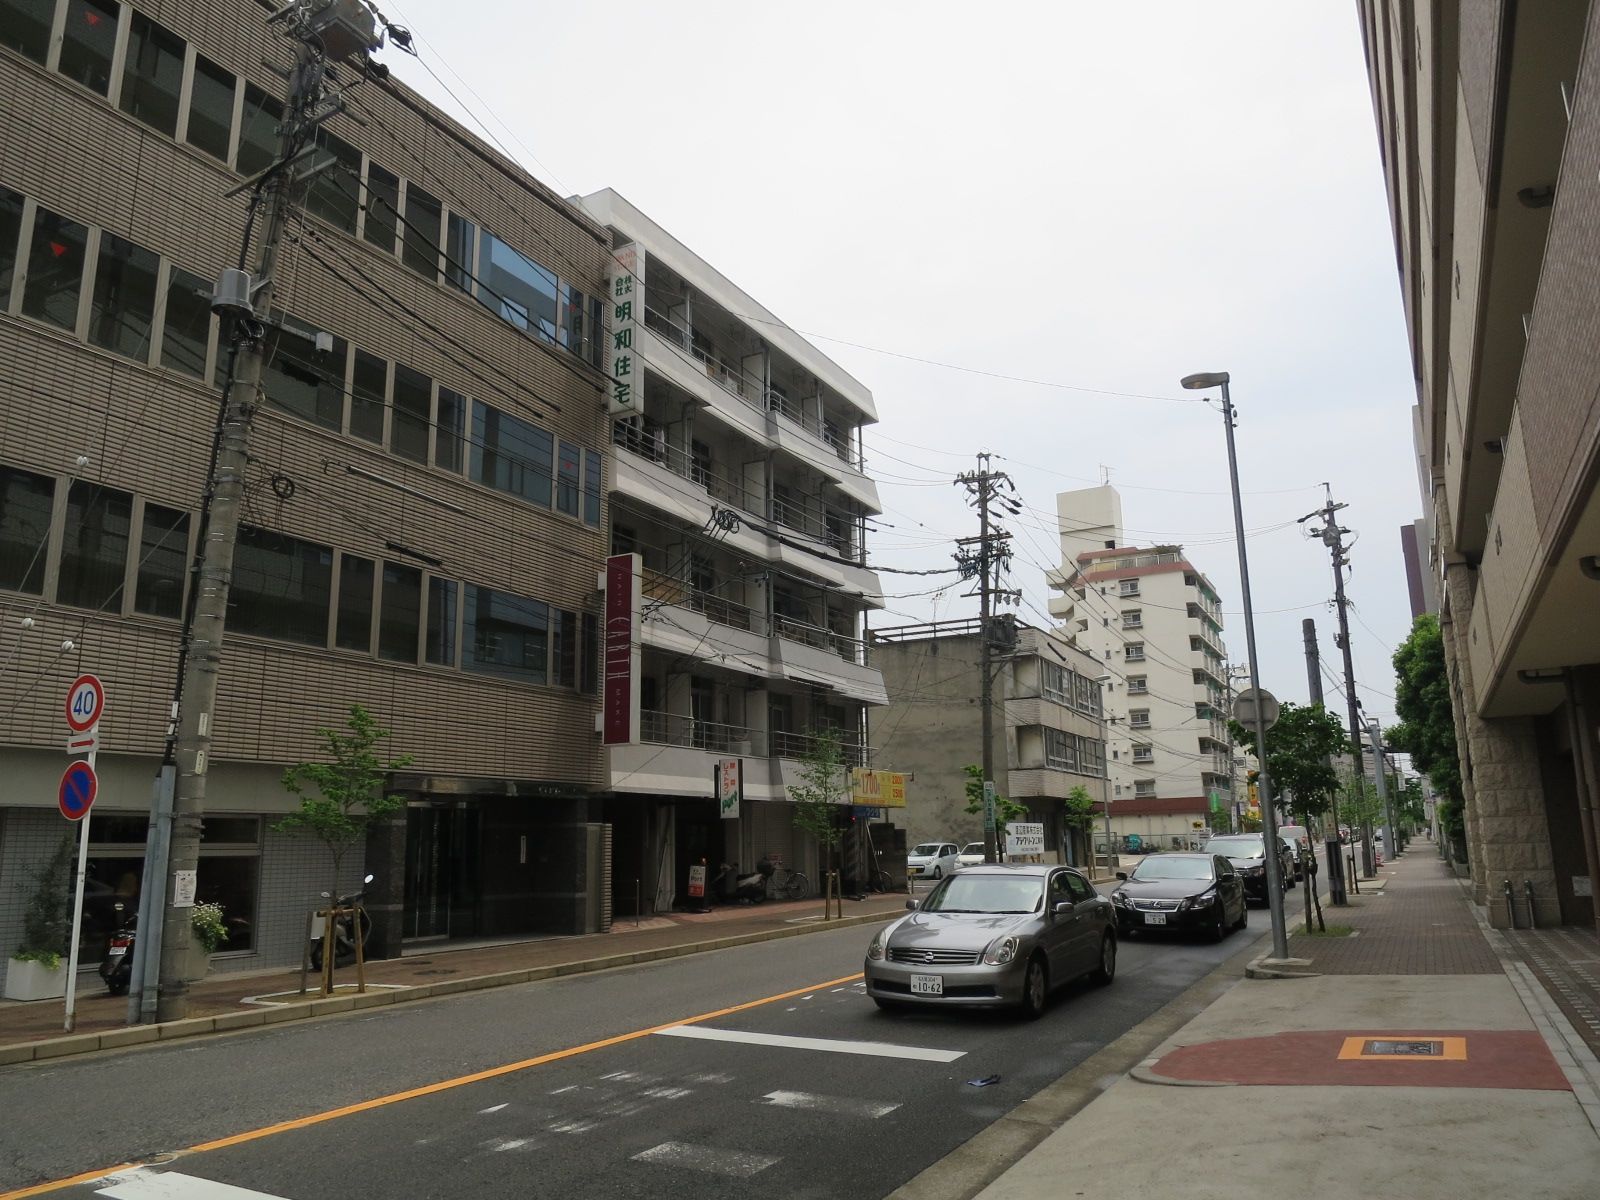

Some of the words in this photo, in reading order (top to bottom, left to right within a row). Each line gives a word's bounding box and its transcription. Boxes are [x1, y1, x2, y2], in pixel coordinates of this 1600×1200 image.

[614, 300, 632, 405] 明和住宅
[73, 690, 95, 716] 40
